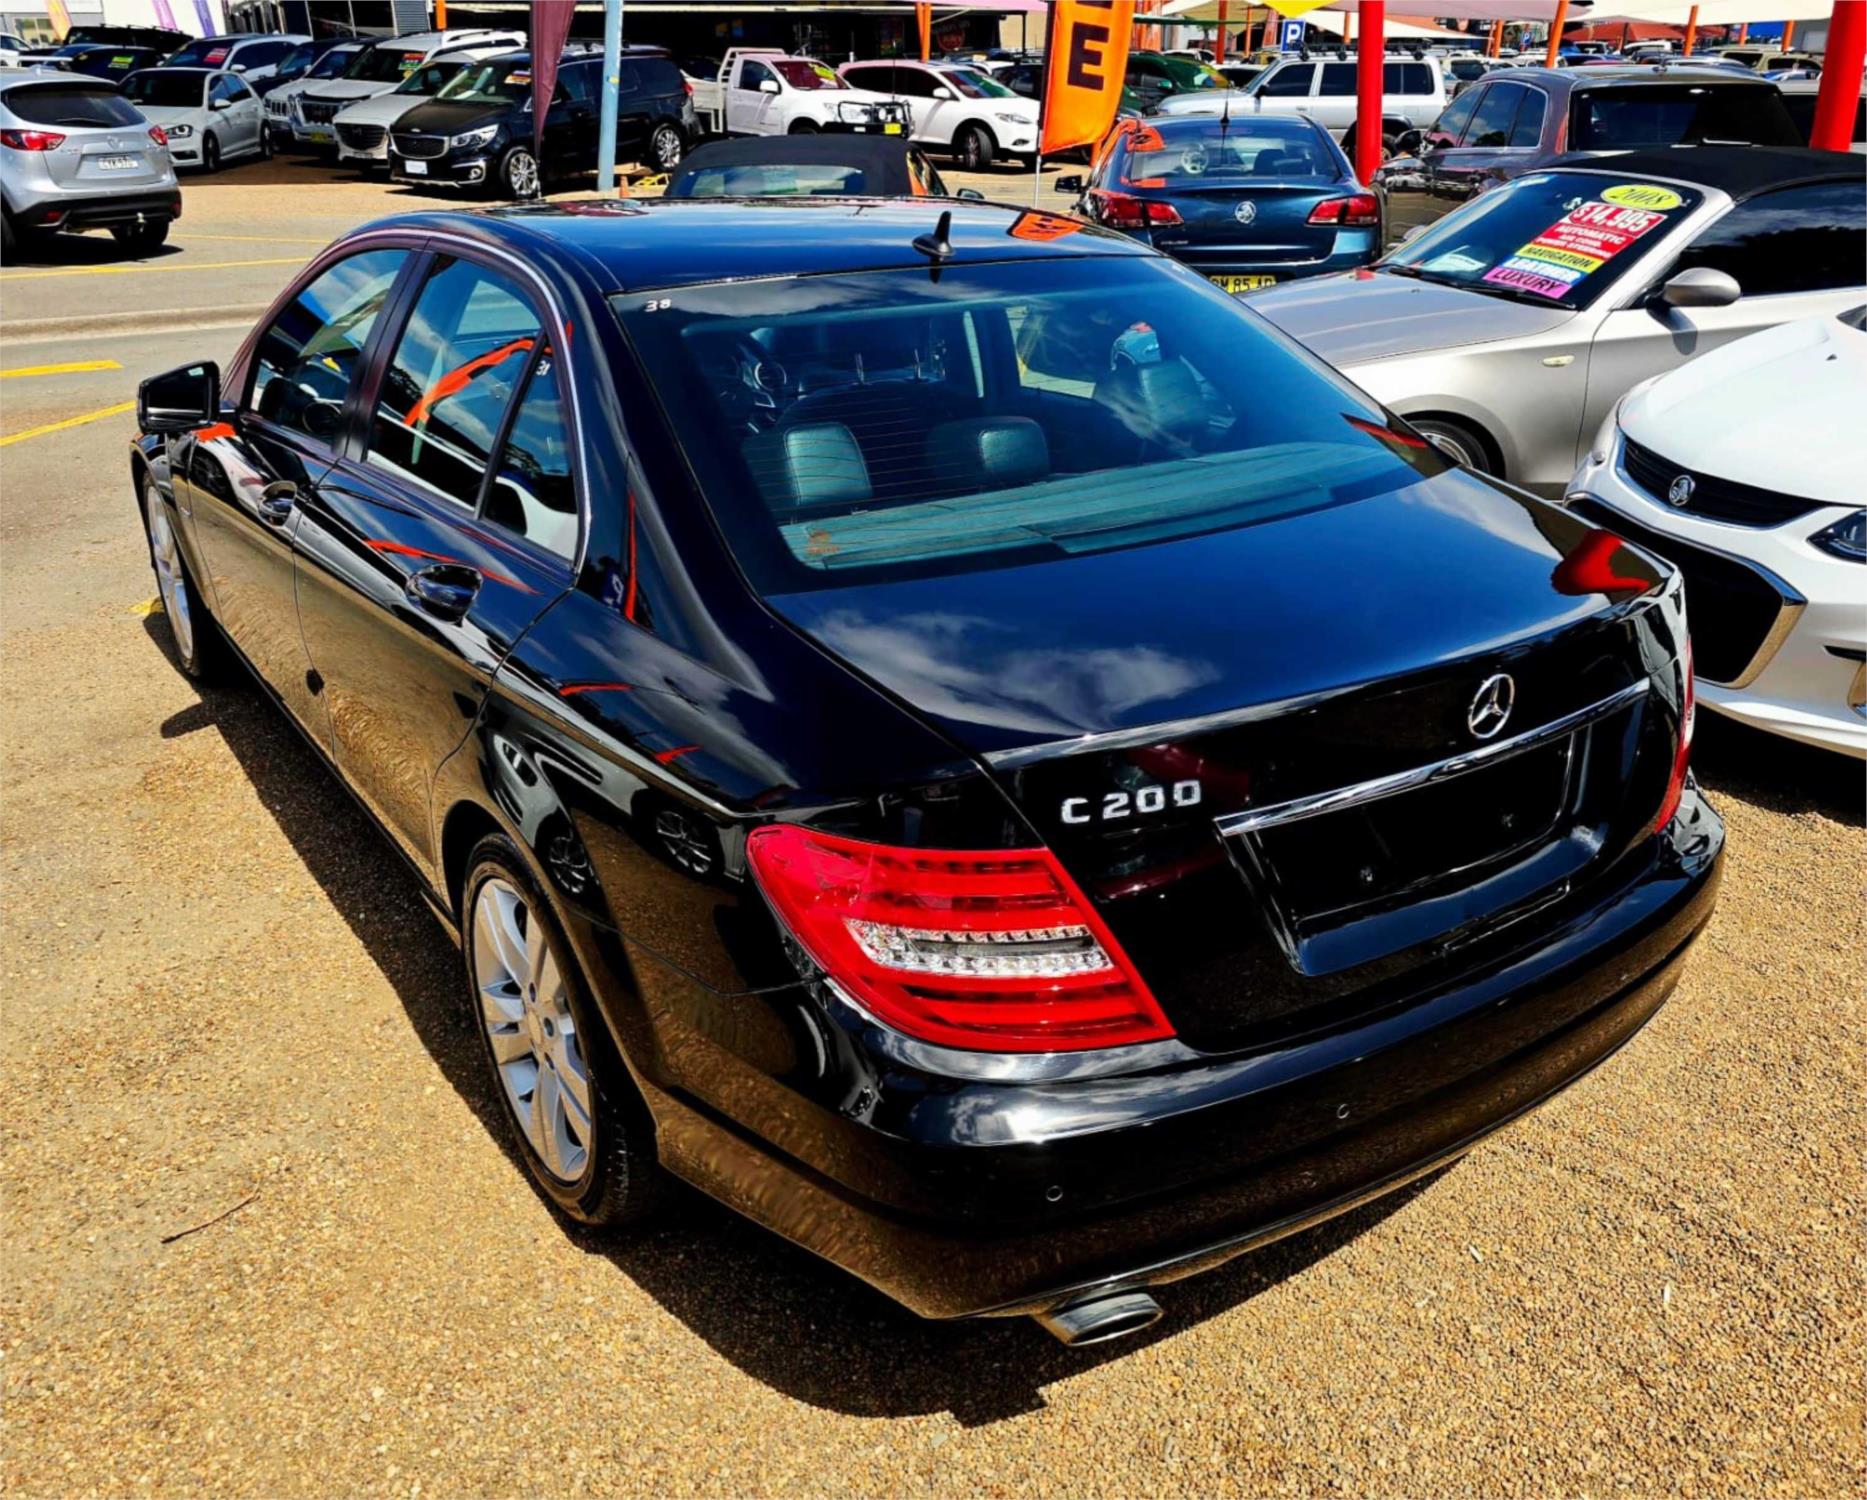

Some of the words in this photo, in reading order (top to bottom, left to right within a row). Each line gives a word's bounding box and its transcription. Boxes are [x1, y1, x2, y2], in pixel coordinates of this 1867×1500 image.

[1286, 23, 1302, 44] P
[1067, 0, 1113, 91] E
[1609, 187, 1672, 206] 2008
[1572, 203, 1656, 233] $14,995
[1555, 225, 1626, 244] AUTOMATIC
[1524, 246, 1594, 268] NAVIGATION
[1493, 269, 1562, 292] LUXURY
[644, 298, 672, 313] 38
[1061, 797, 1091, 824] C
[1102, 779, 1201, 820] 200
